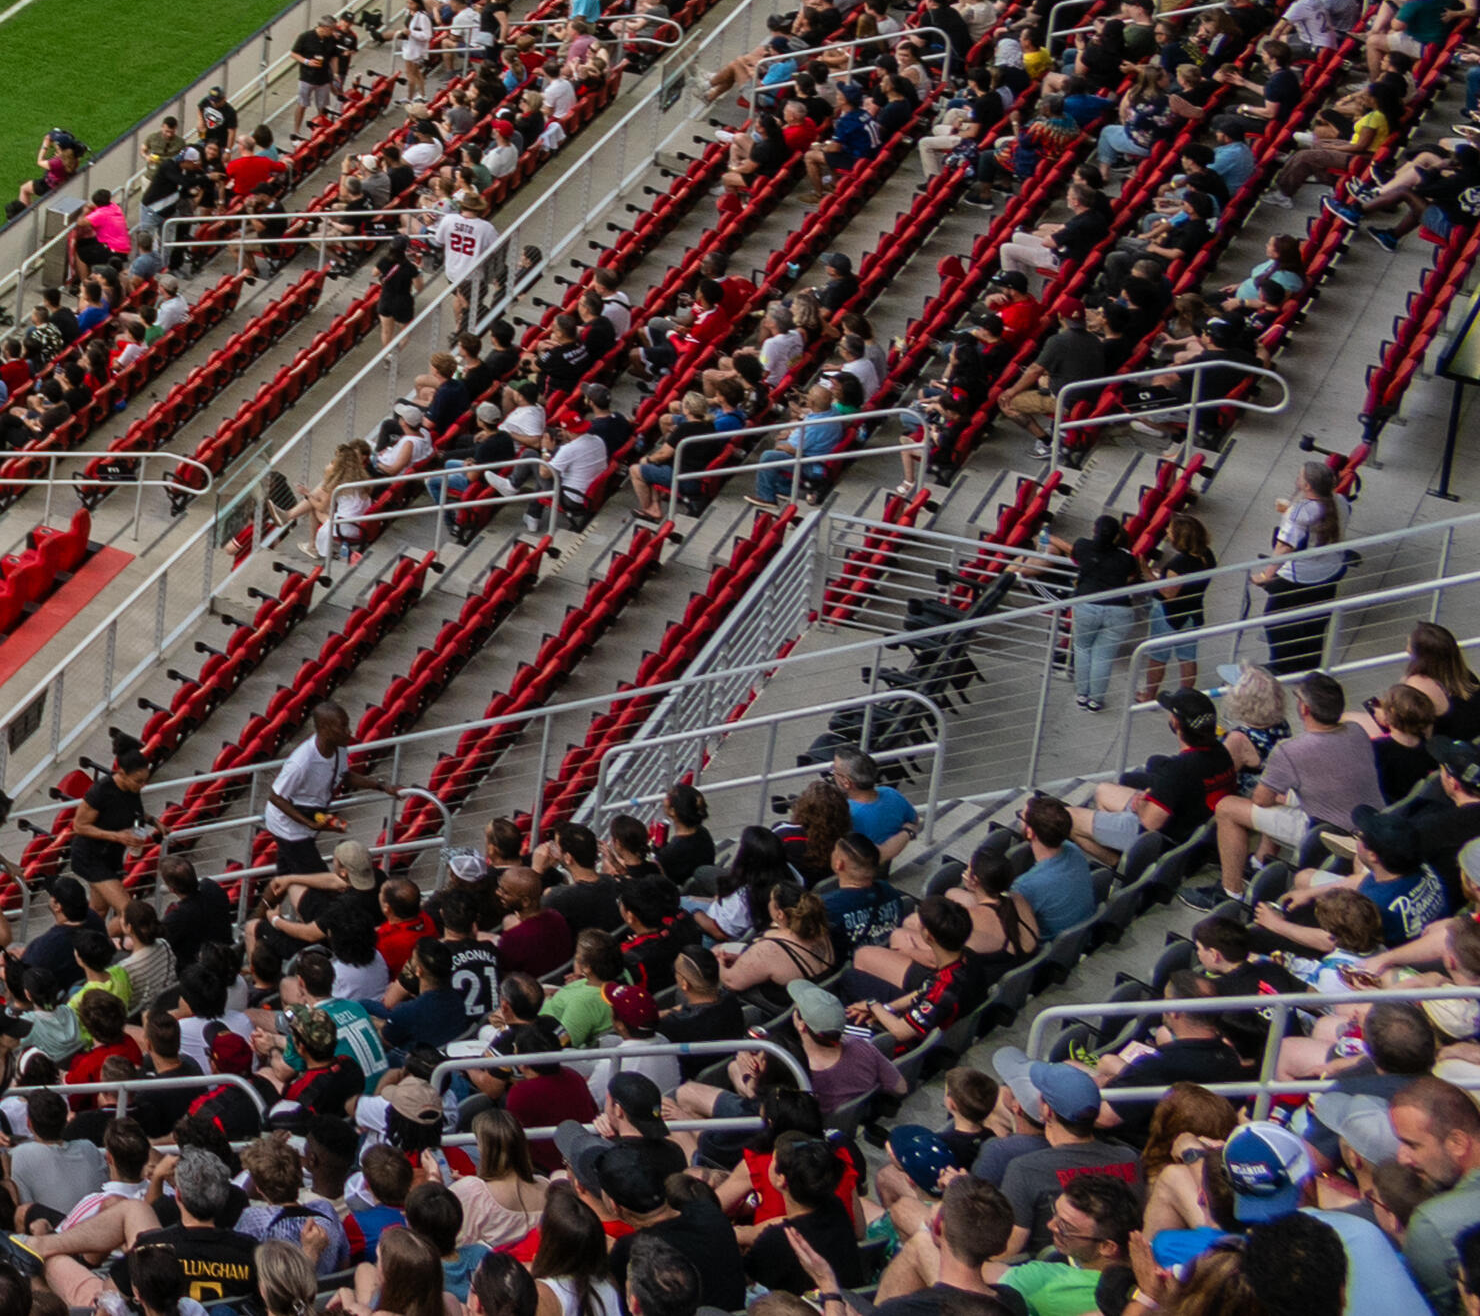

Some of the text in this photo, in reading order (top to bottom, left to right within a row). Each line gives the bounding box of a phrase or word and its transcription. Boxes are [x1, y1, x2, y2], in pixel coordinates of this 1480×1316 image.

[450, 232, 476, 257] 22
[451, 966, 500, 1017] 21
[336, 1017, 389, 1078] 10
